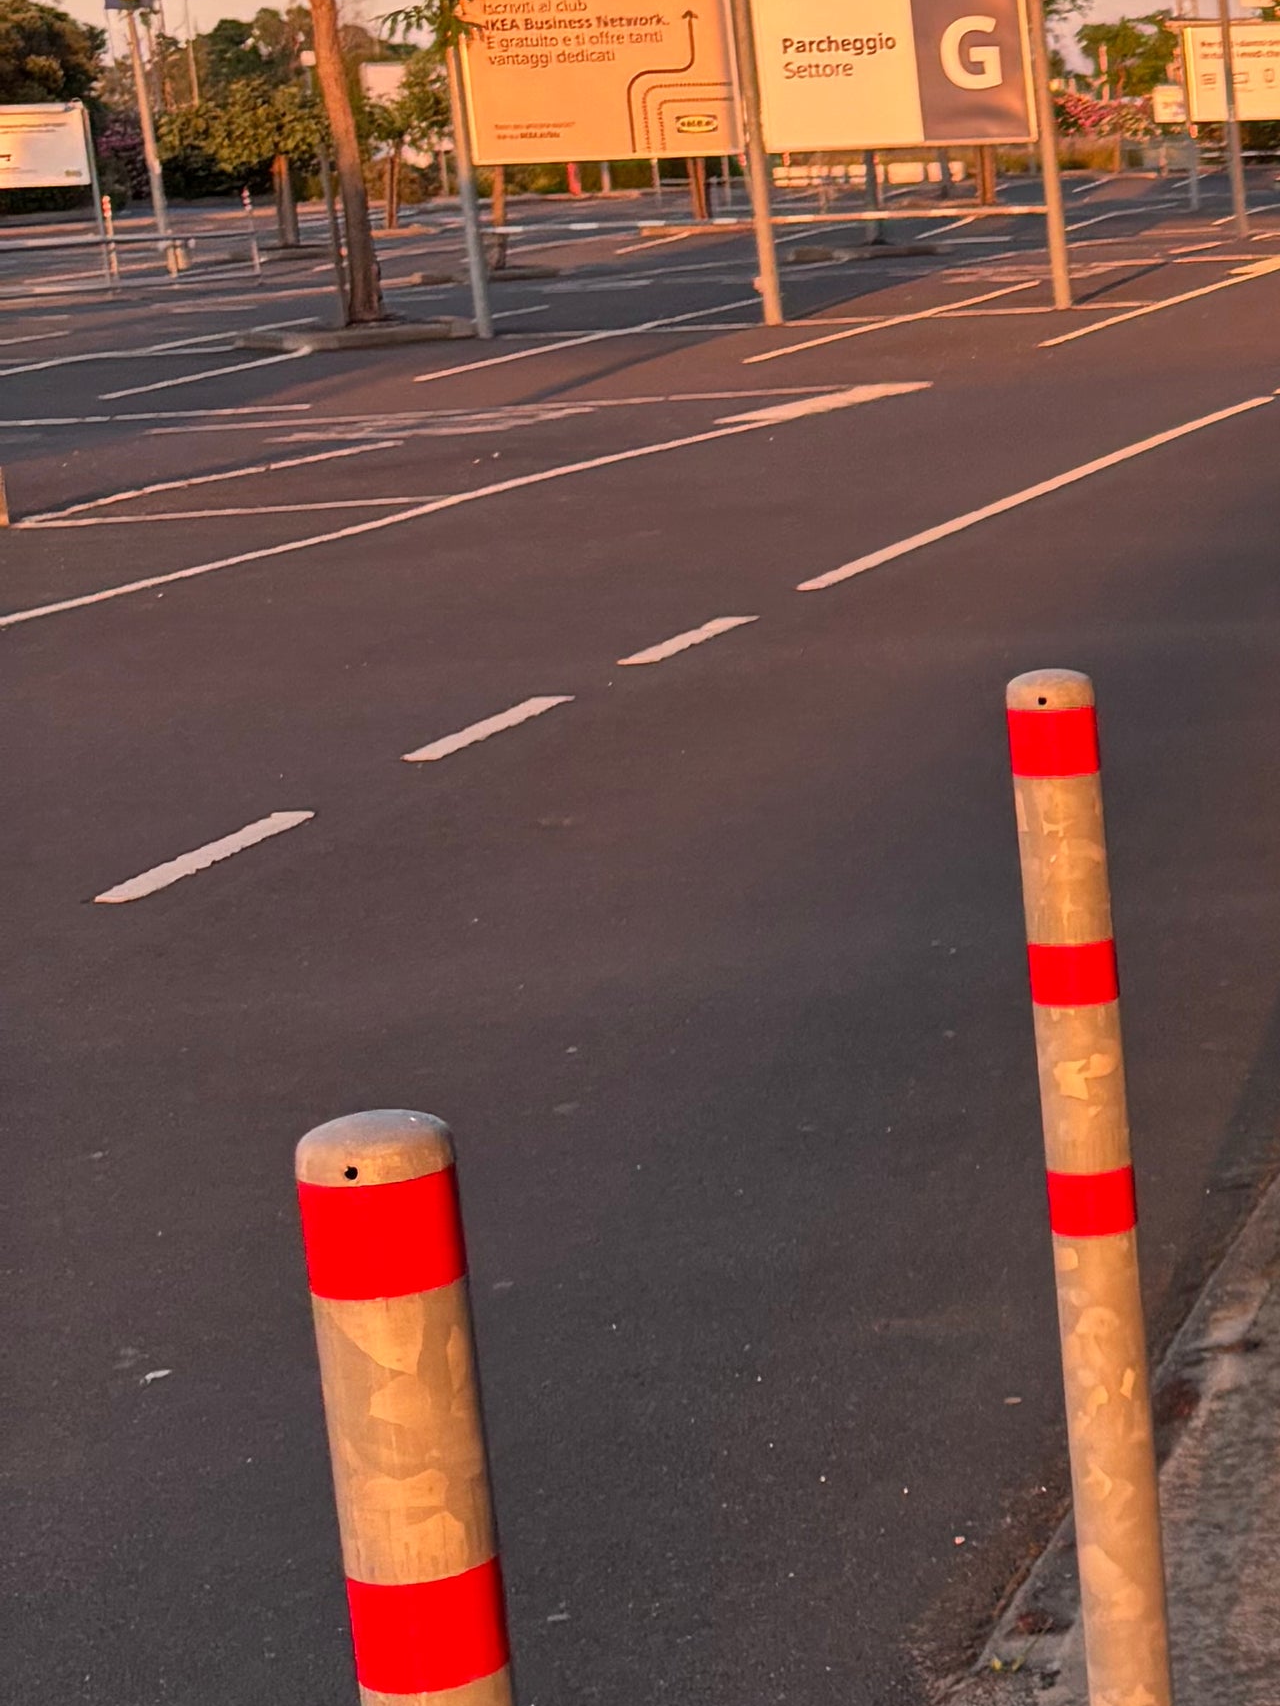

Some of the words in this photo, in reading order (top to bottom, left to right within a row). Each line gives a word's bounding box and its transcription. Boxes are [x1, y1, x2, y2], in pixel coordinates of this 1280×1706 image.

[484, 17, 521, 32] IKEA
[524, 15, 593, 31] Business
[500, 33, 560, 53] gratuito
[589, 30, 625, 46] offre
[781, 32, 897, 56] Parcheggio
[940, 15, 1003, 90] G
[488, 51, 553, 70] vantaggi
[556, 49, 616, 64] dedicati
[782, 61, 854, 80] Settore
